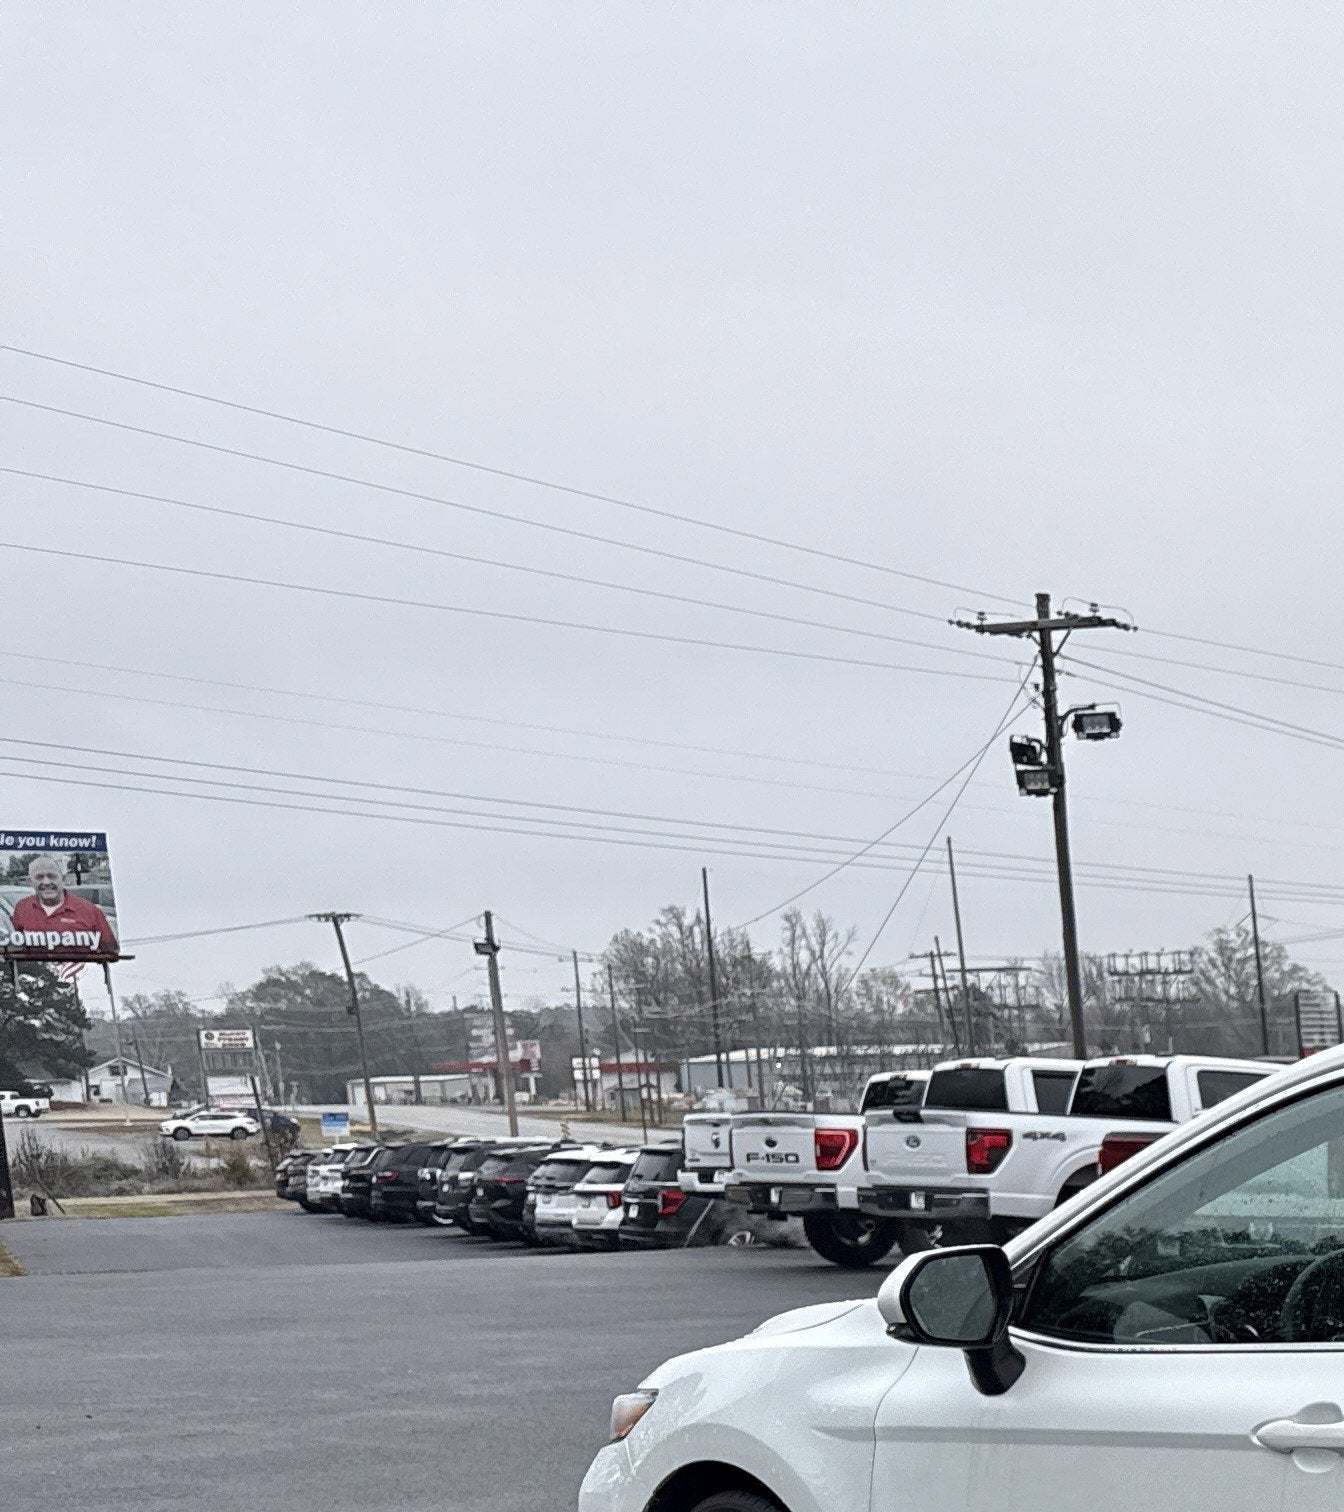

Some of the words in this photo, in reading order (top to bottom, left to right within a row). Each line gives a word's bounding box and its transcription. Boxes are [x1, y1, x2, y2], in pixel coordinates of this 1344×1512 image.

[18, 835, 46, 848] you
[49, 834, 98, 848] know!
[745, 1152, 800, 1164] F-150
